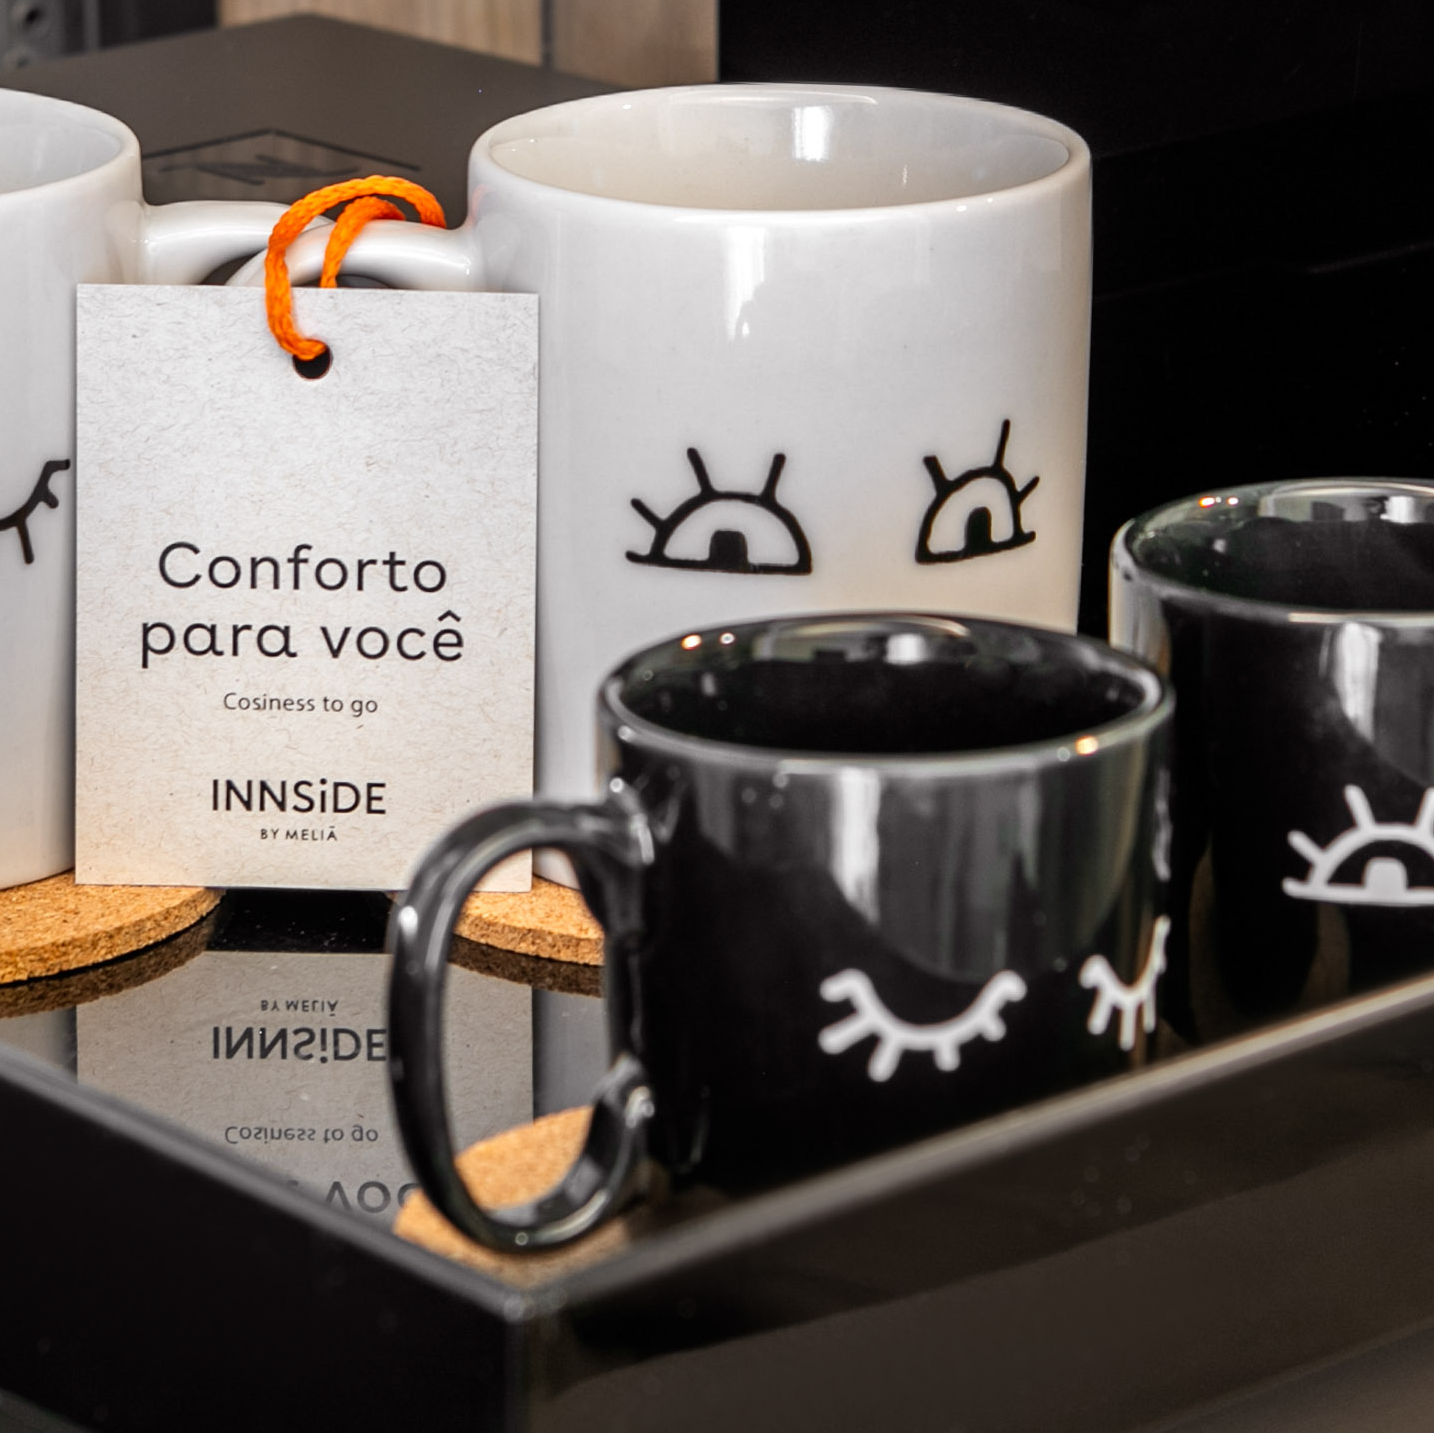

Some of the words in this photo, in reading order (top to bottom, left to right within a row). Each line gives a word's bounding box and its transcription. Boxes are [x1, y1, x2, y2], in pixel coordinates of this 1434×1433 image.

[159, 542, 446, 593] Conforto
[142, 622, 297, 669] para
[320, 610, 463, 661] você
[224, 693, 315, 711] Cosiness
[323, 697, 343, 712] to
[351, 700, 378, 717] go
[261, 829, 279, 839] BY
